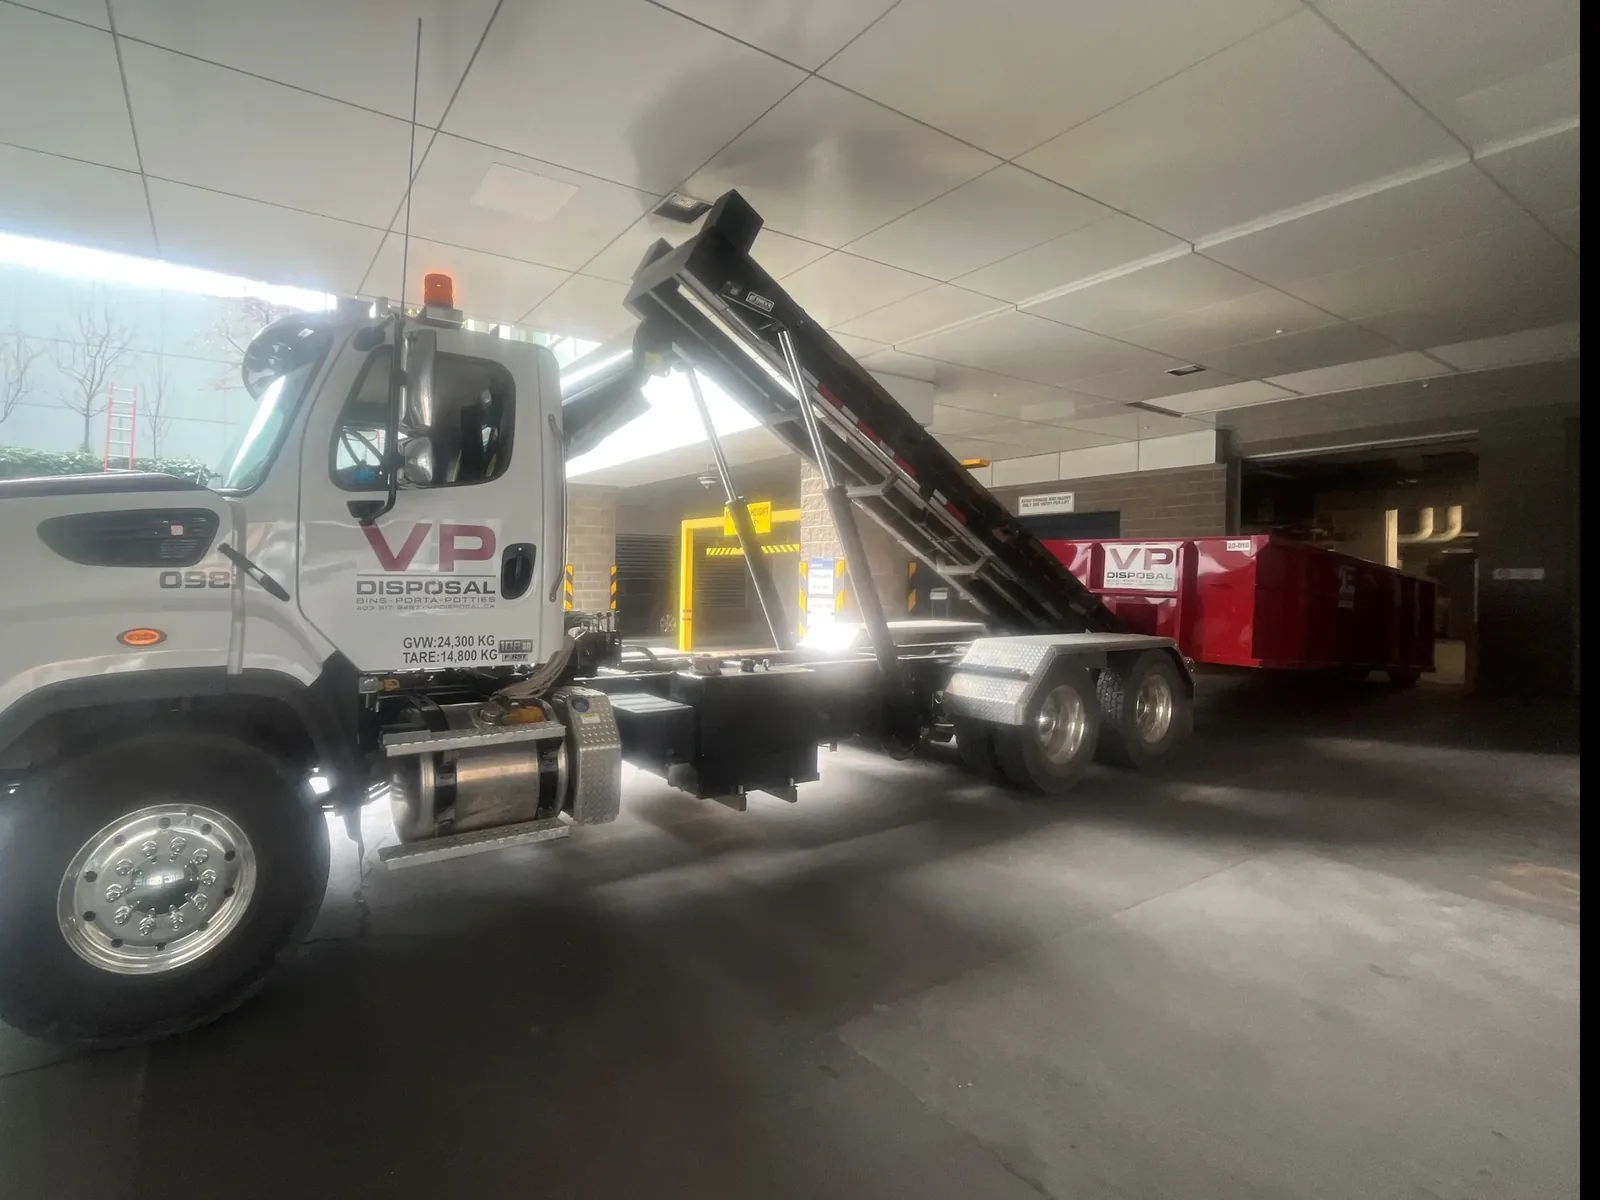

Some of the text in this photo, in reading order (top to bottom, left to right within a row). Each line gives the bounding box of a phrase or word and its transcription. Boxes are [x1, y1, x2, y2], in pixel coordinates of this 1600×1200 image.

[358, 520, 496, 572] VP
[1109, 548, 1173, 570] VP
[1106, 571, 1173, 580] DISPOSAL
[356, 580, 496, 595] DISPOSAL
[403, 634, 496, 650] GVW:24,300 KG
[402, 648, 499, 664] TARE:14,800 KG
